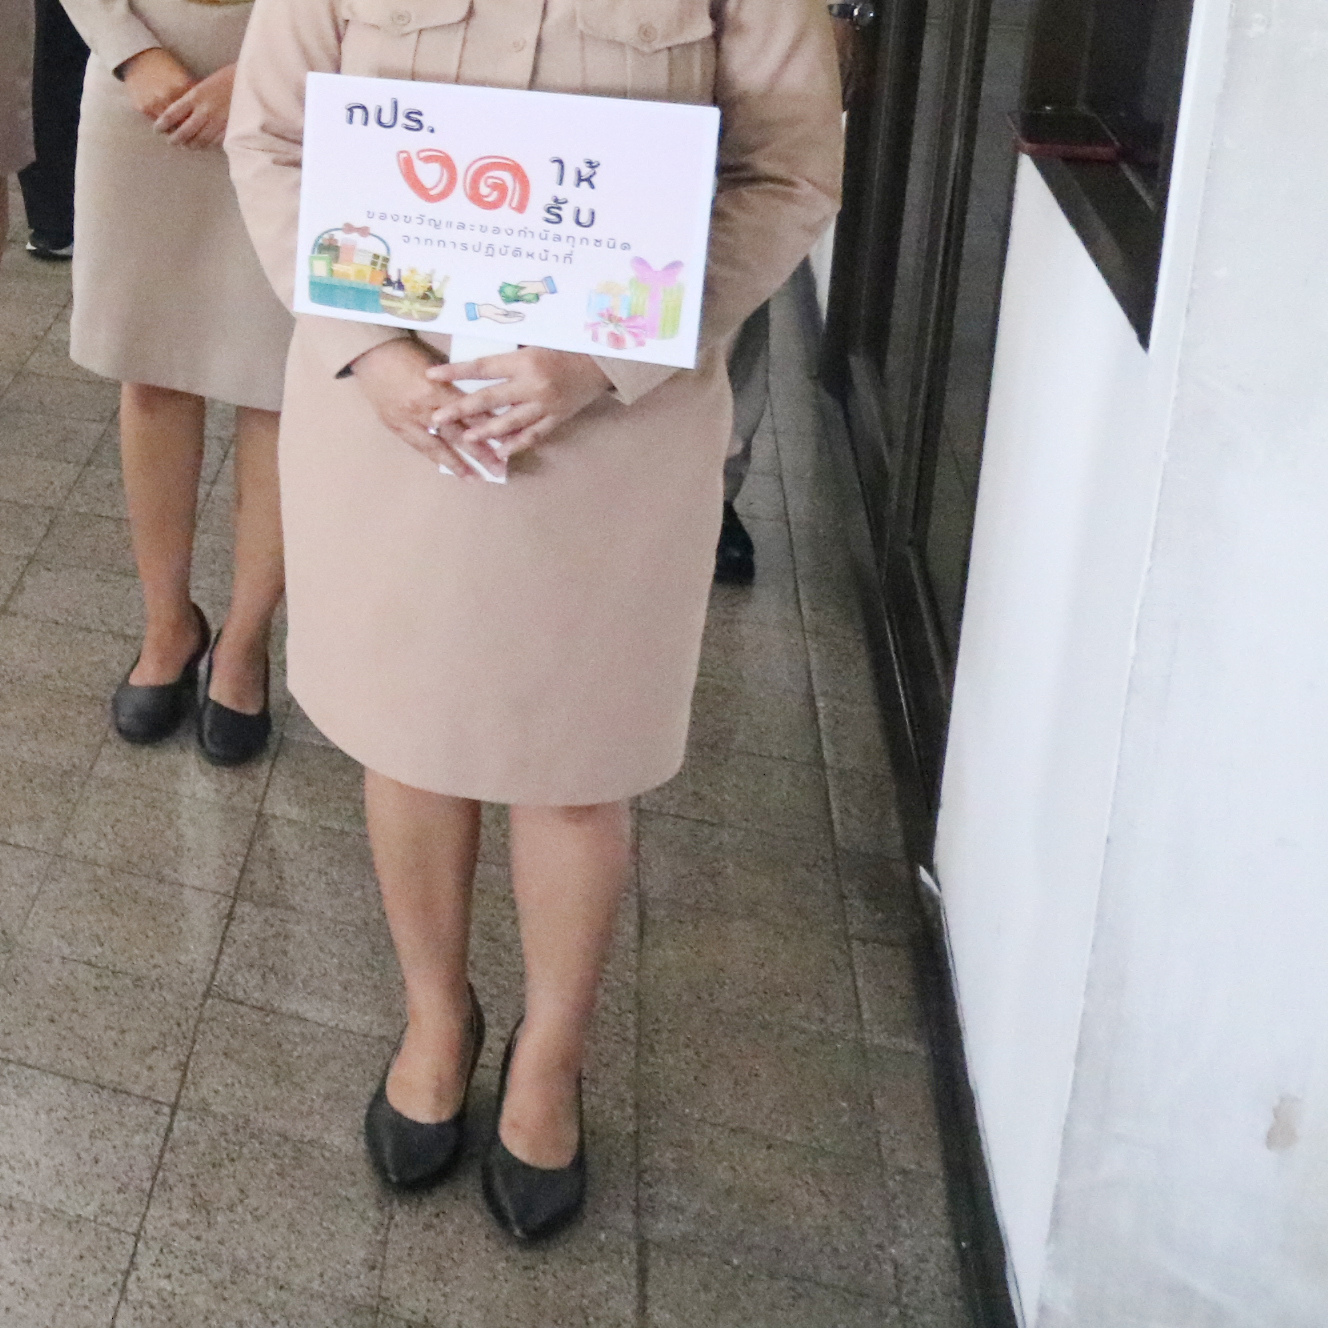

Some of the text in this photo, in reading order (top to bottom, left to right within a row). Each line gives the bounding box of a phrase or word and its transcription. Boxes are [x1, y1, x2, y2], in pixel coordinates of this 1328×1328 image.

[344, 97, 436, 134] กปร.
[397, 147, 531, 215] งด
[549, 156, 601, 190] ให้
[542, 195, 597, 229] รับ
[365, 209, 633, 252] ของขวัญและของกำนัลทุกชนิด
[402, 234, 574, 265] จากการปฏิบัติหน้าที่
